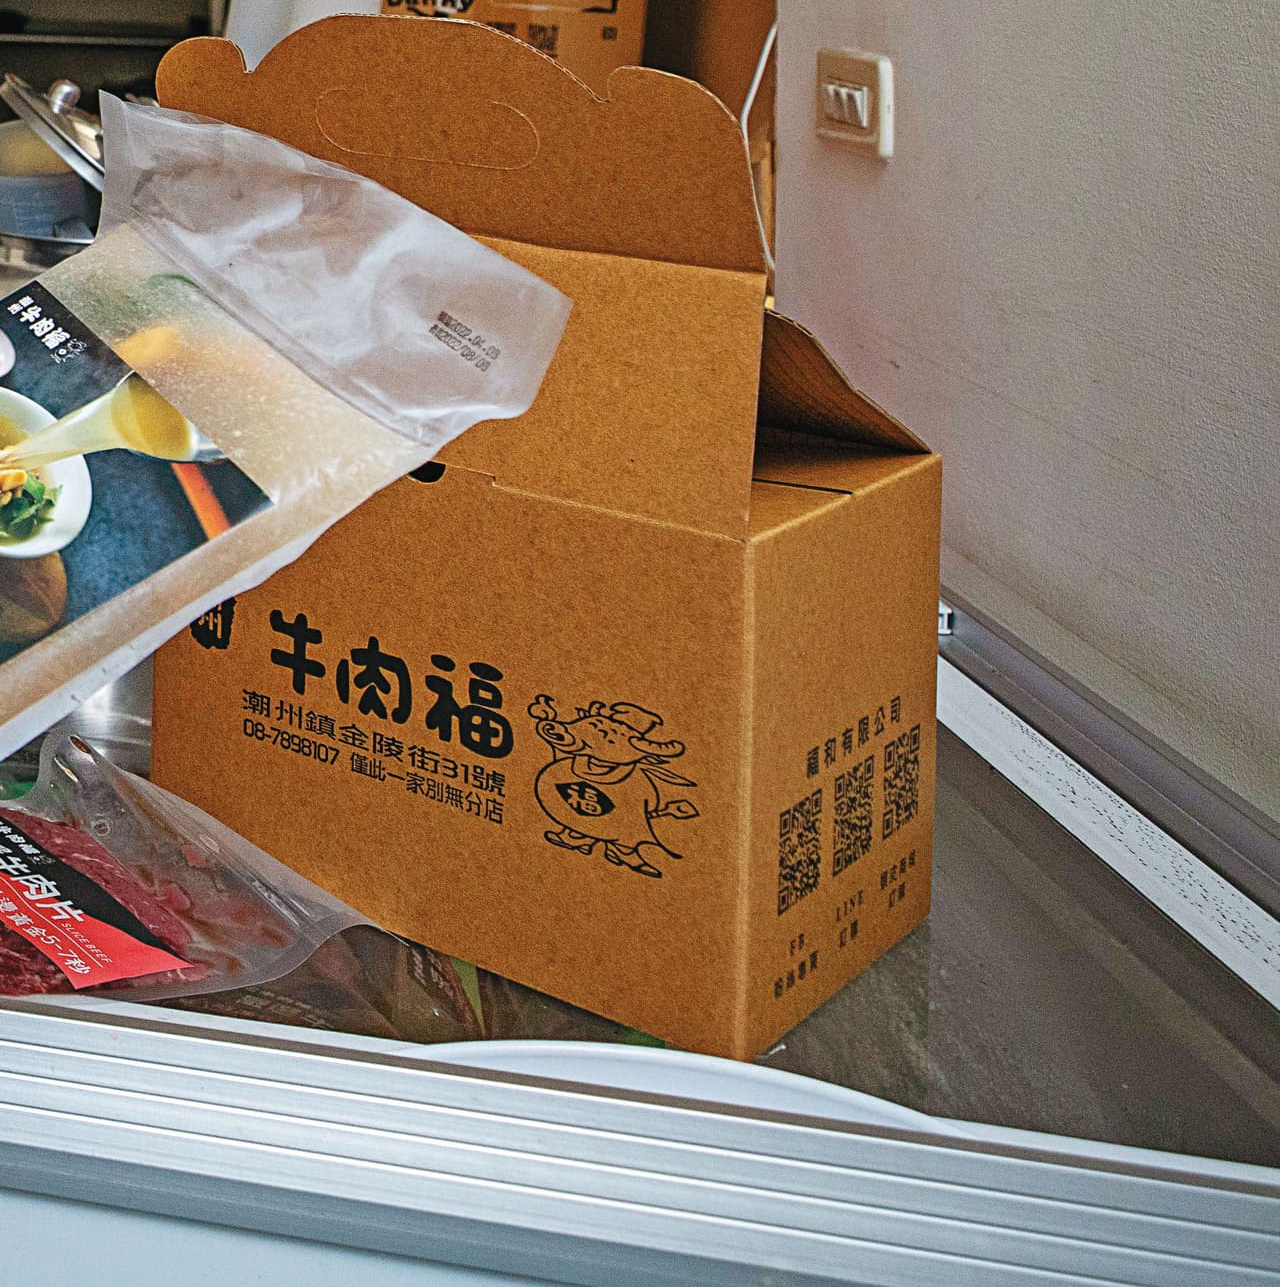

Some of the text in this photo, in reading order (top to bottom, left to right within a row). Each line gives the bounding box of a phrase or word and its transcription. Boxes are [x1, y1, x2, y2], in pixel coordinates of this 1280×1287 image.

[20, 305, 71, 350] 牛肉福
[269, 609, 514, 759] 牛肉福
[242, 689, 507, 798] 潮州鎮金陵街31號
[243, 718, 505, 825] 08-7898107 僅此一家別無分店
[567, 784, 602, 814] 福
[836, 889, 864, 922] LINE
[62, 922, 113, 964] SLICE BEEF
